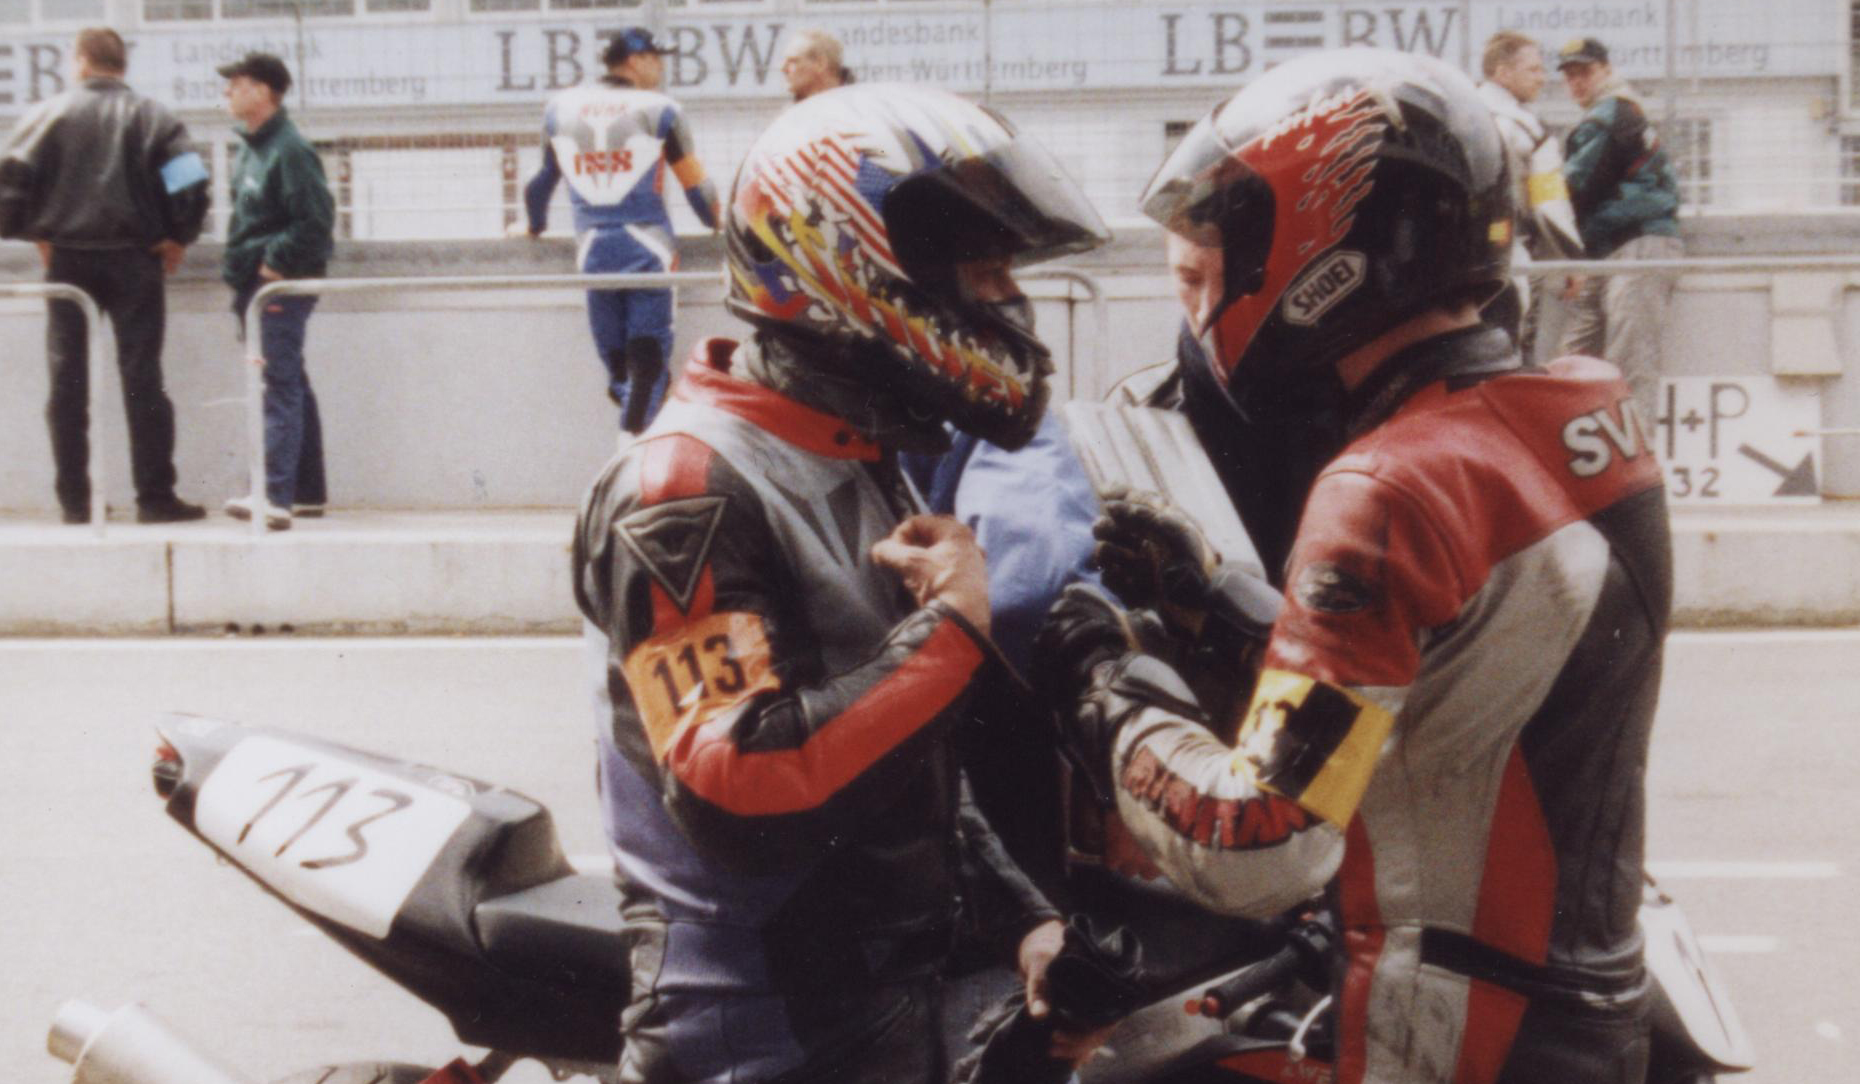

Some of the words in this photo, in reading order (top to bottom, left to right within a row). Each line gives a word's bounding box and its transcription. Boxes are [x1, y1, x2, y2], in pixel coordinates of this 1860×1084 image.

[838, 19, 980, 45] andesbank
[1291, 259, 1357, 317] SHOEI
[1671, 466, 1720, 498] 32
[652, 633, 747, 718] 113
[237, 763, 415, 870] 113
